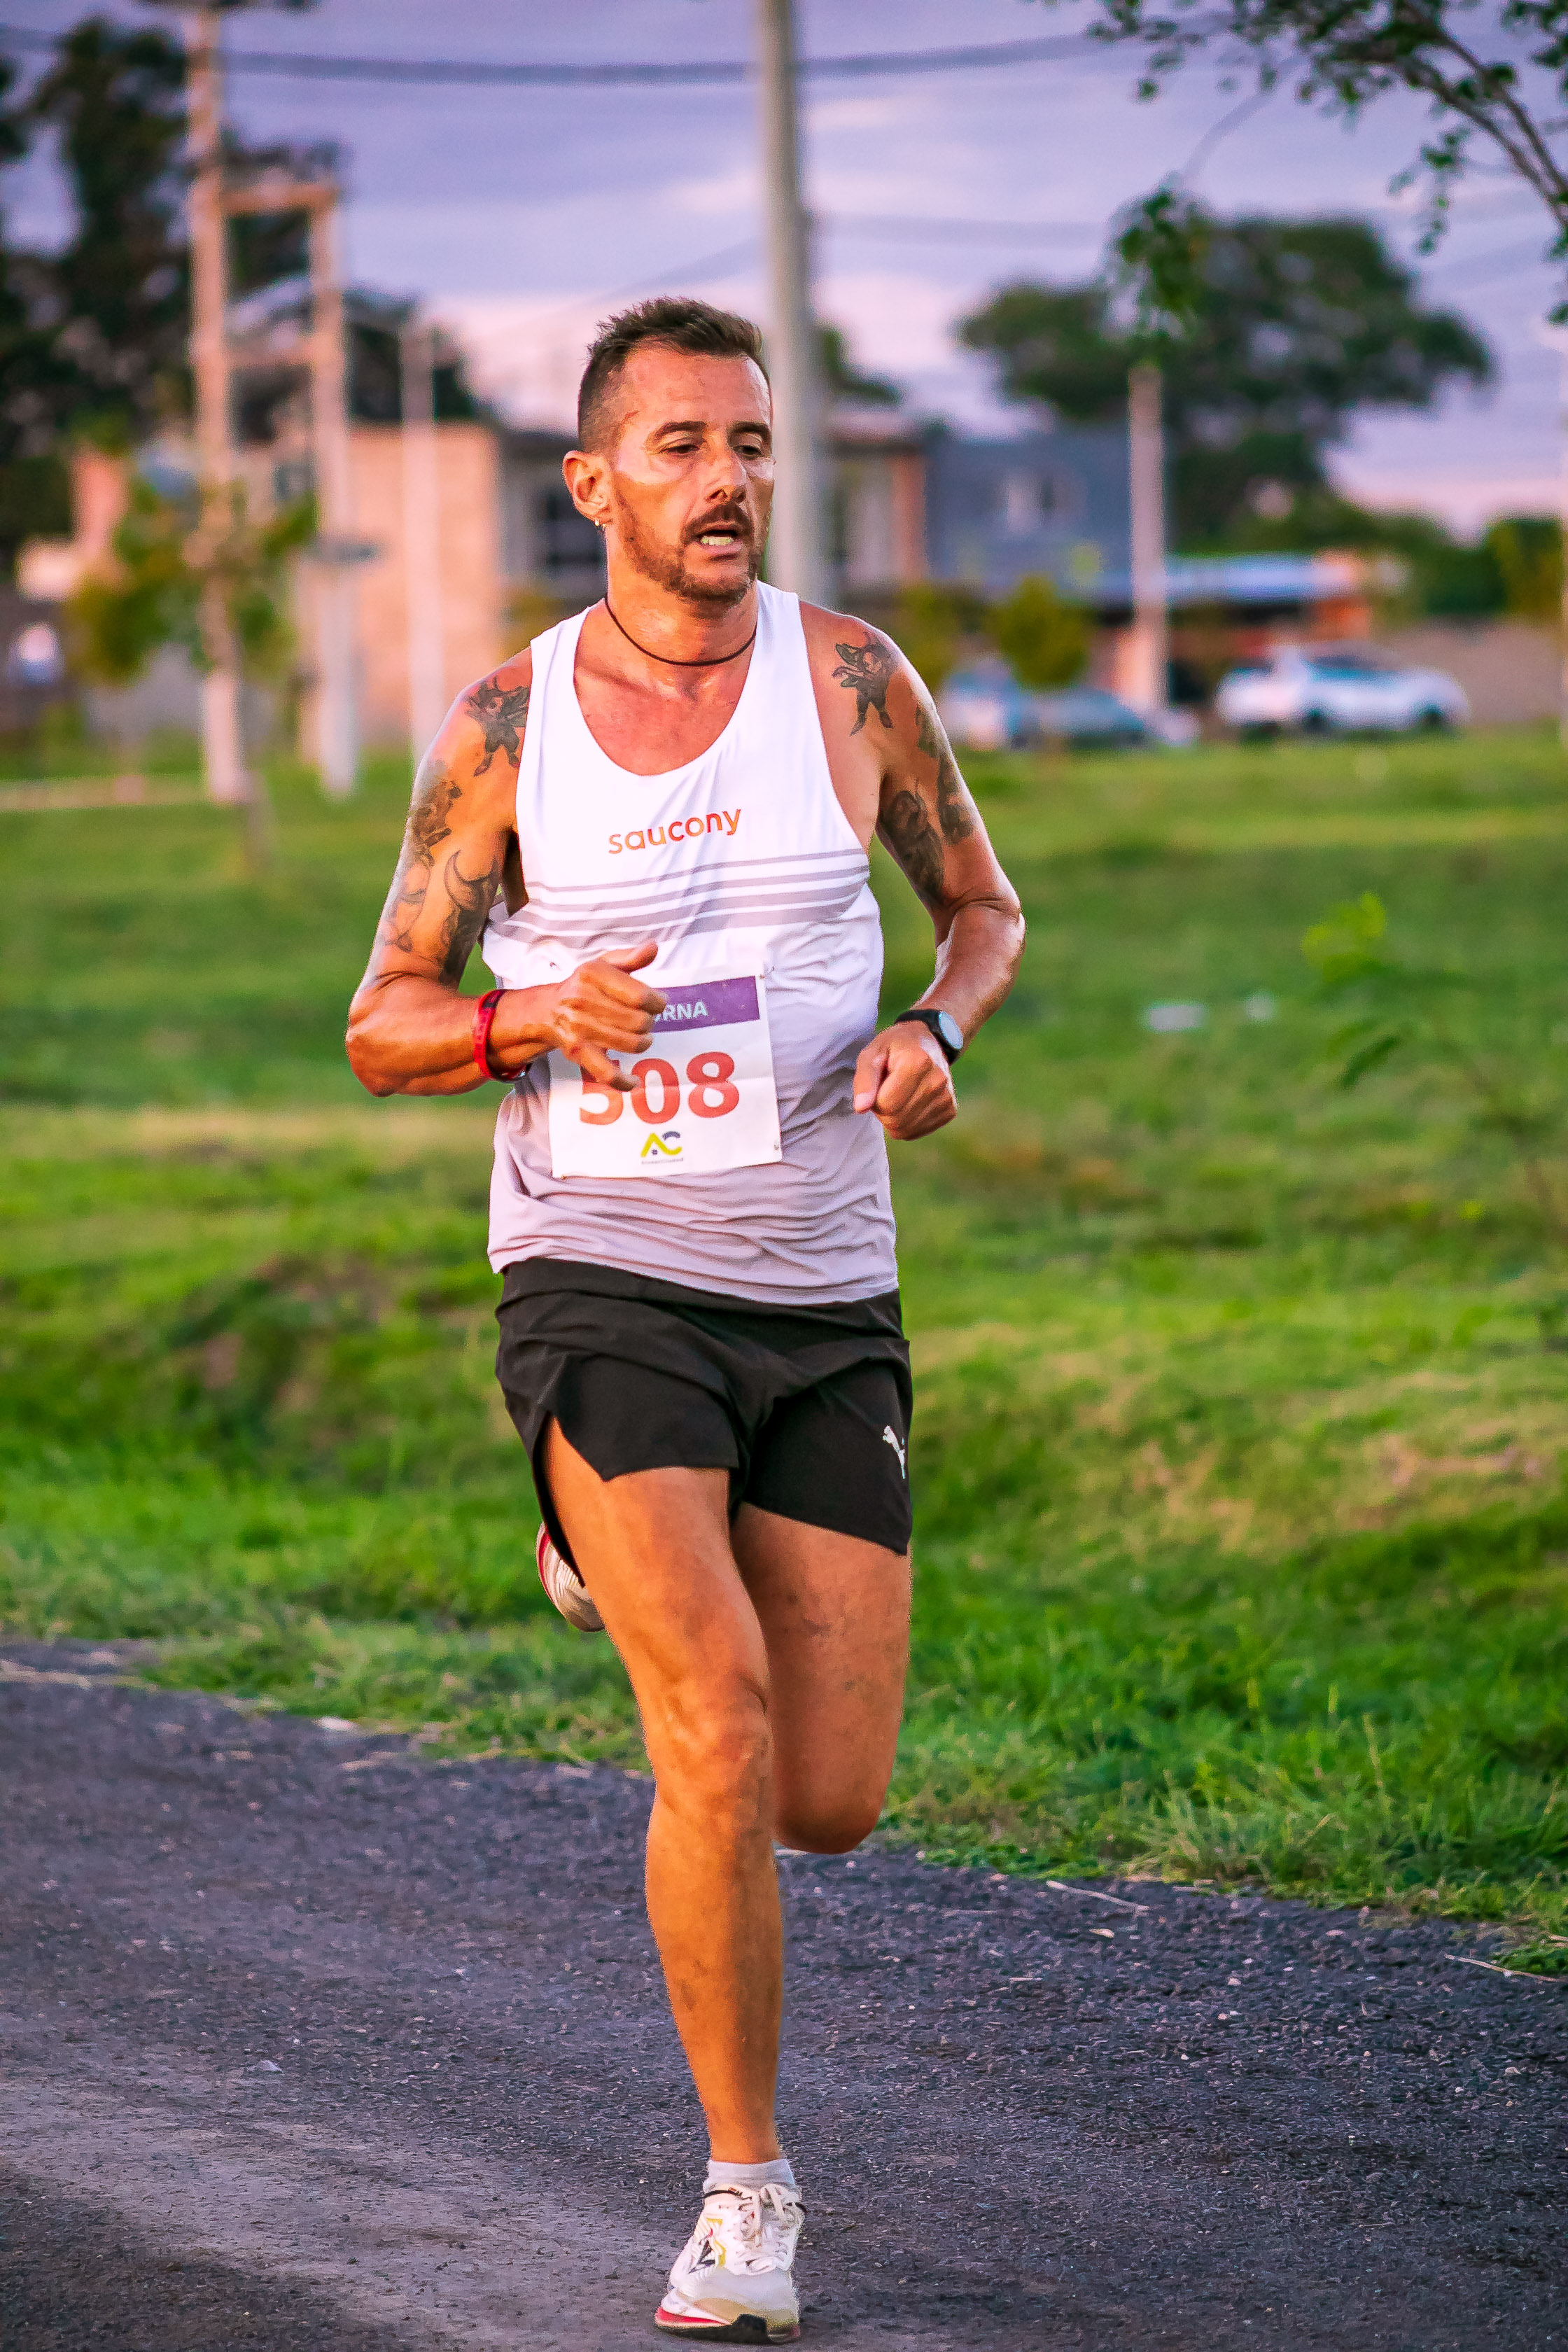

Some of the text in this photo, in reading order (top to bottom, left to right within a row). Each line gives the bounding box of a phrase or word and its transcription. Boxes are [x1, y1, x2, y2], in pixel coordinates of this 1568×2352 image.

[608, 808, 741, 854] saucony
[654, 1000, 708, 1023] RNA
[580, 1051, 739, 1126] 508
